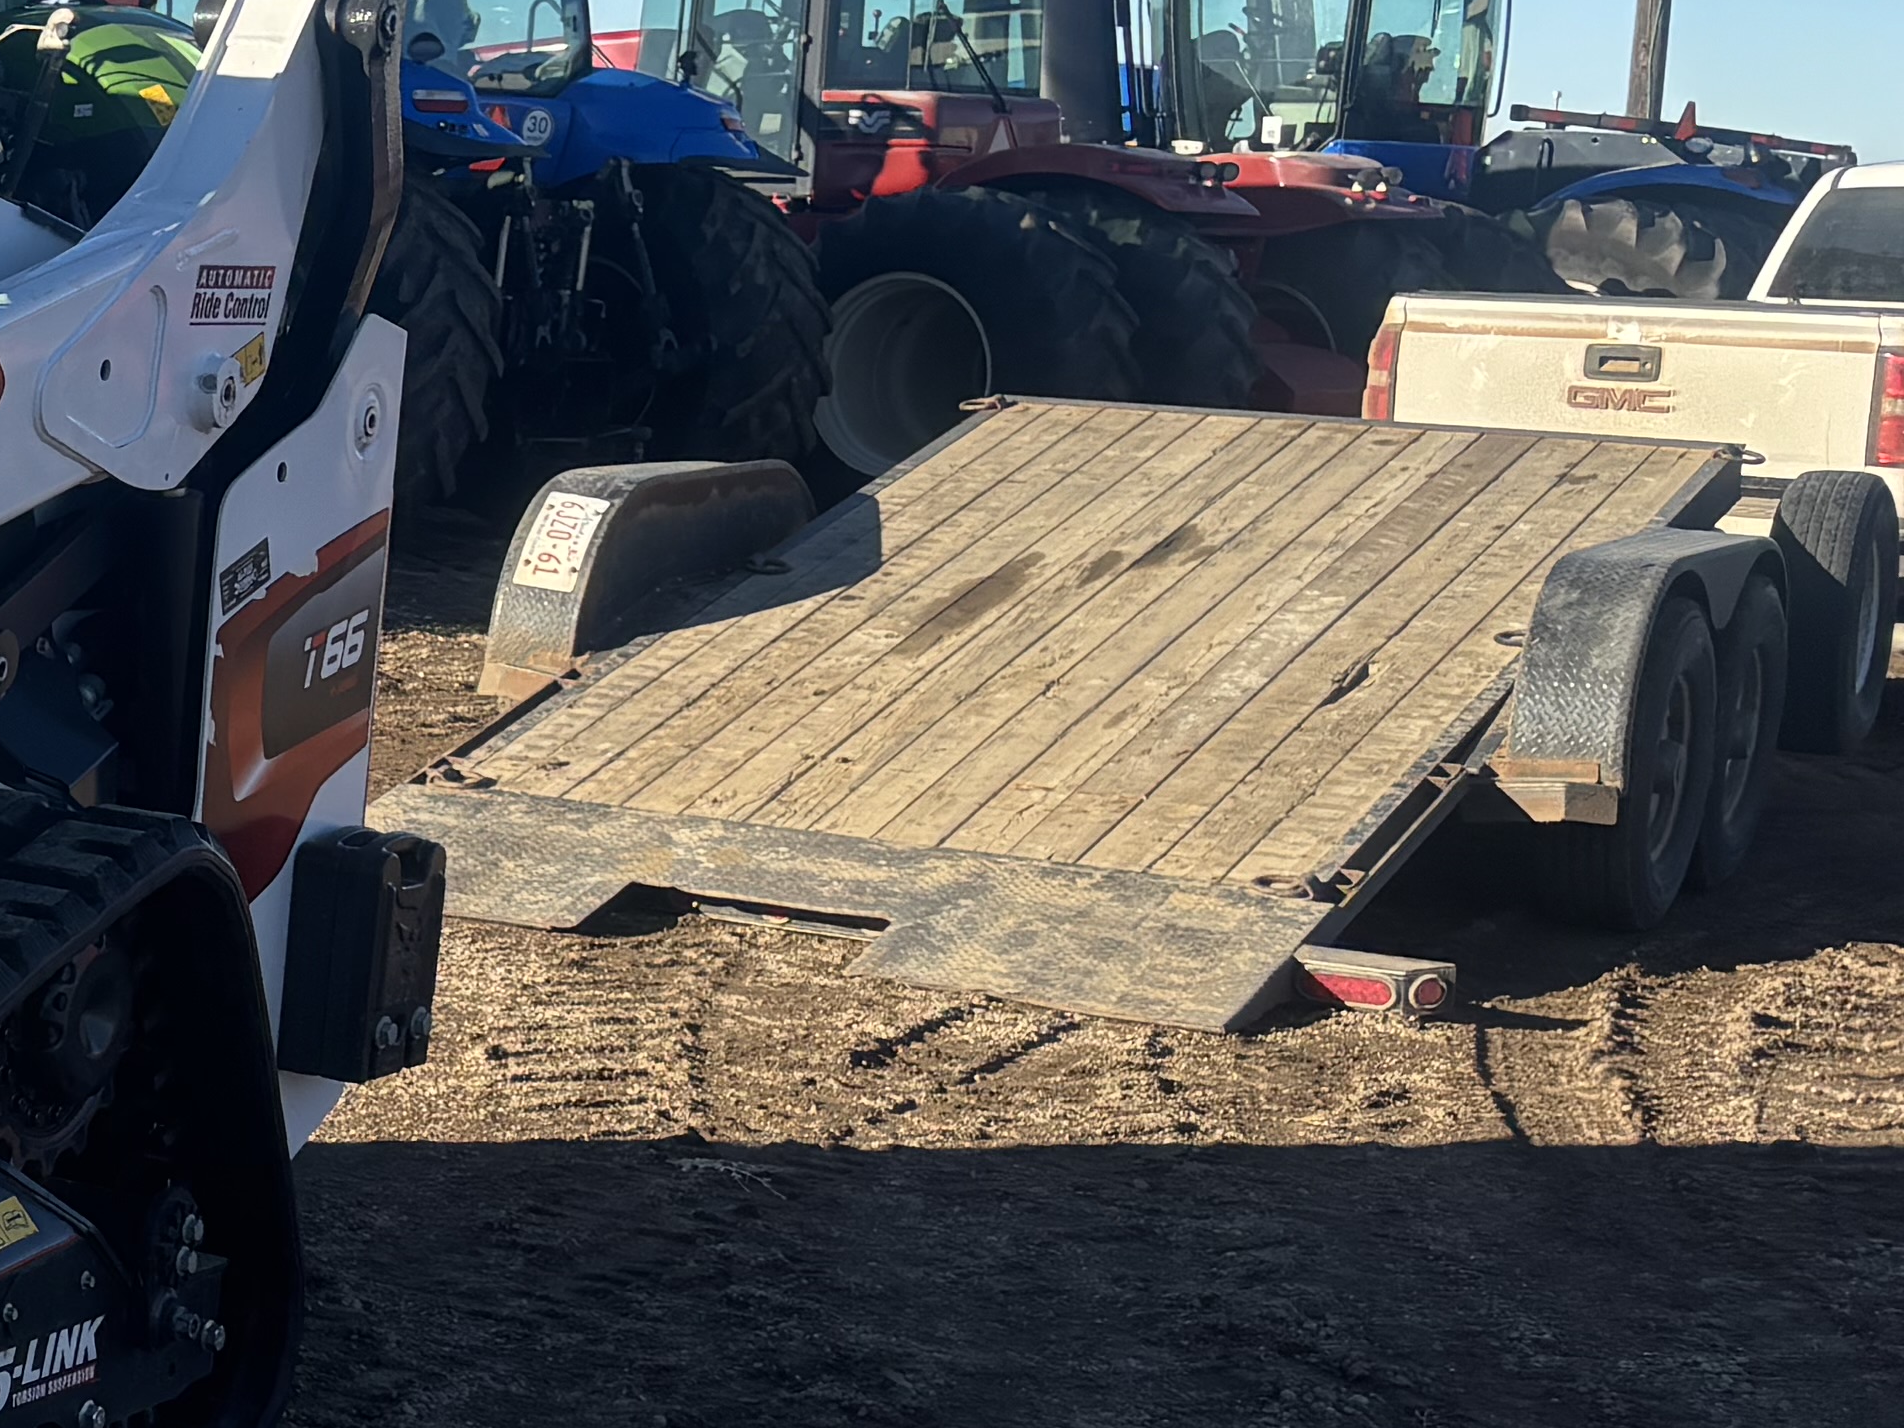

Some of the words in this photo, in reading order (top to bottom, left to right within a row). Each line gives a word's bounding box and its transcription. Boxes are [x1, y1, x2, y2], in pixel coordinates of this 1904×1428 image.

[527, 116, 549, 135] 30
[198, 268, 274, 288] AUTOMATIC
[190, 291, 222, 320] Ride
[223, 291, 272, 320] Control
[1567, 385, 1671, 414] GMC
[303, 608, 370, 689] T66
